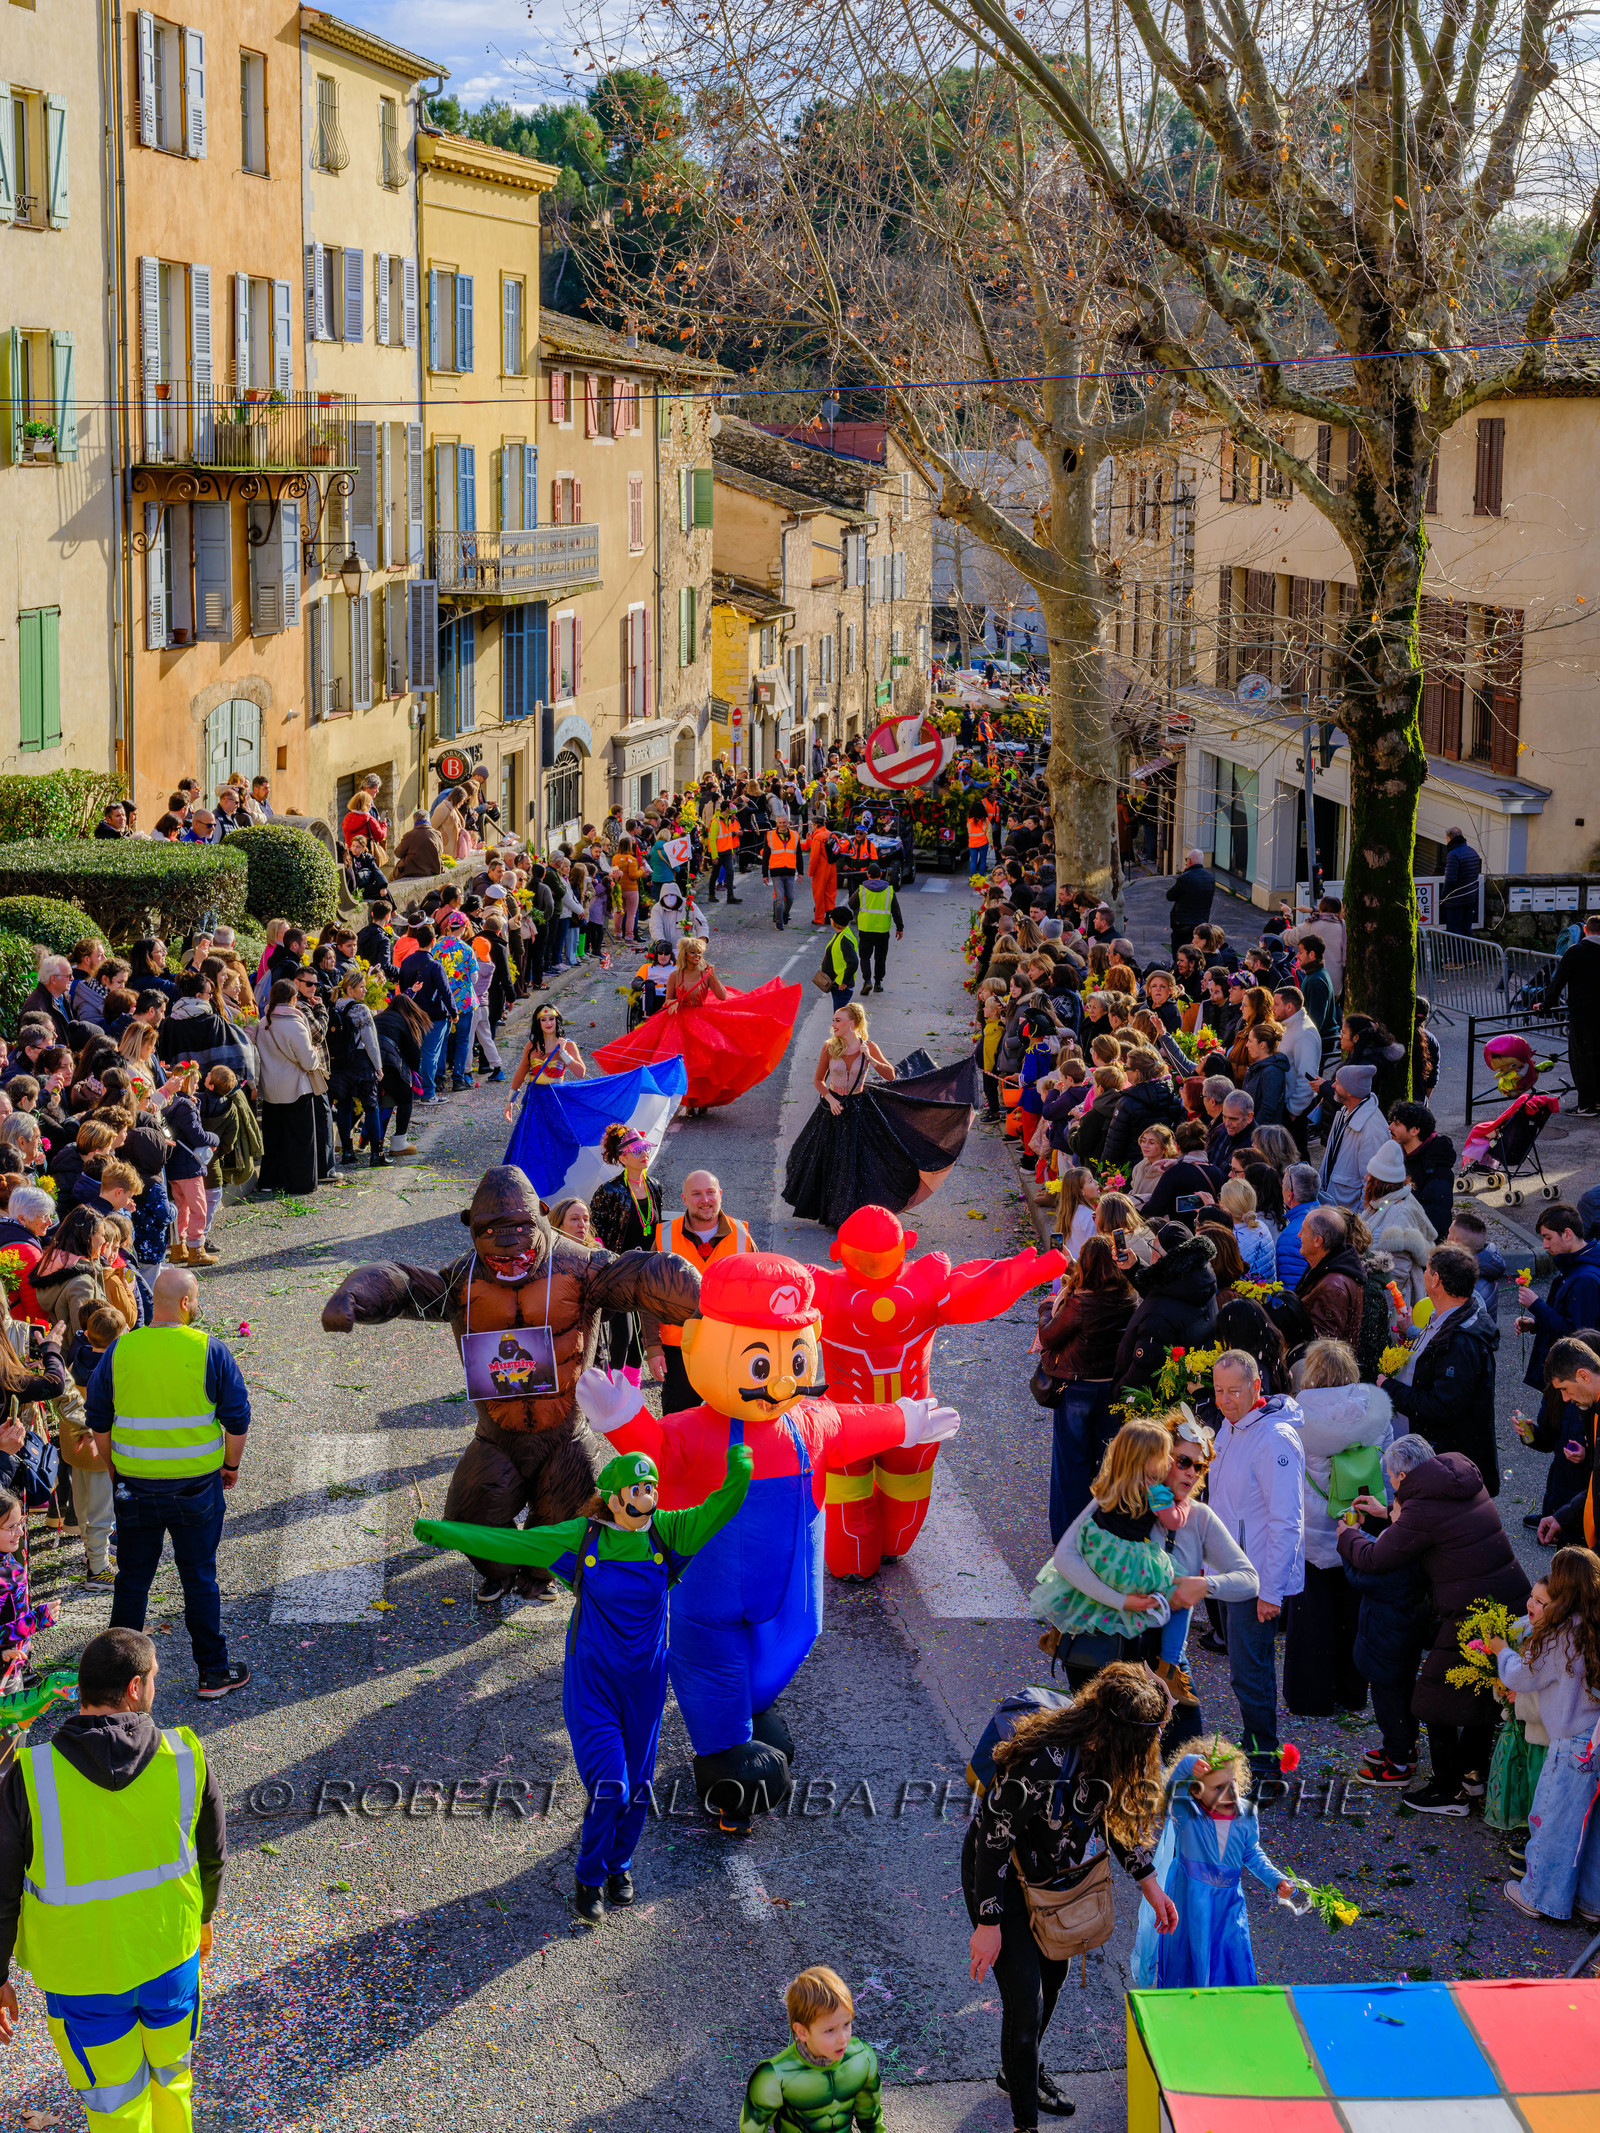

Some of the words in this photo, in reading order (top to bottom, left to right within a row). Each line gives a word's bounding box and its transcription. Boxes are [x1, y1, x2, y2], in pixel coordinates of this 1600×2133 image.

[441, 750, 465, 760] BARNES
[447, 759, 460, 776] B
[943, 829, 950, 838] 4
[1415, 887, 1428, 895] TO
[1416, 896, 1429, 904] TO
[770, 1289, 799, 1311] M
[487, 1358, 537, 1373] Murphy
[638, 1463, 647, 1475] L
